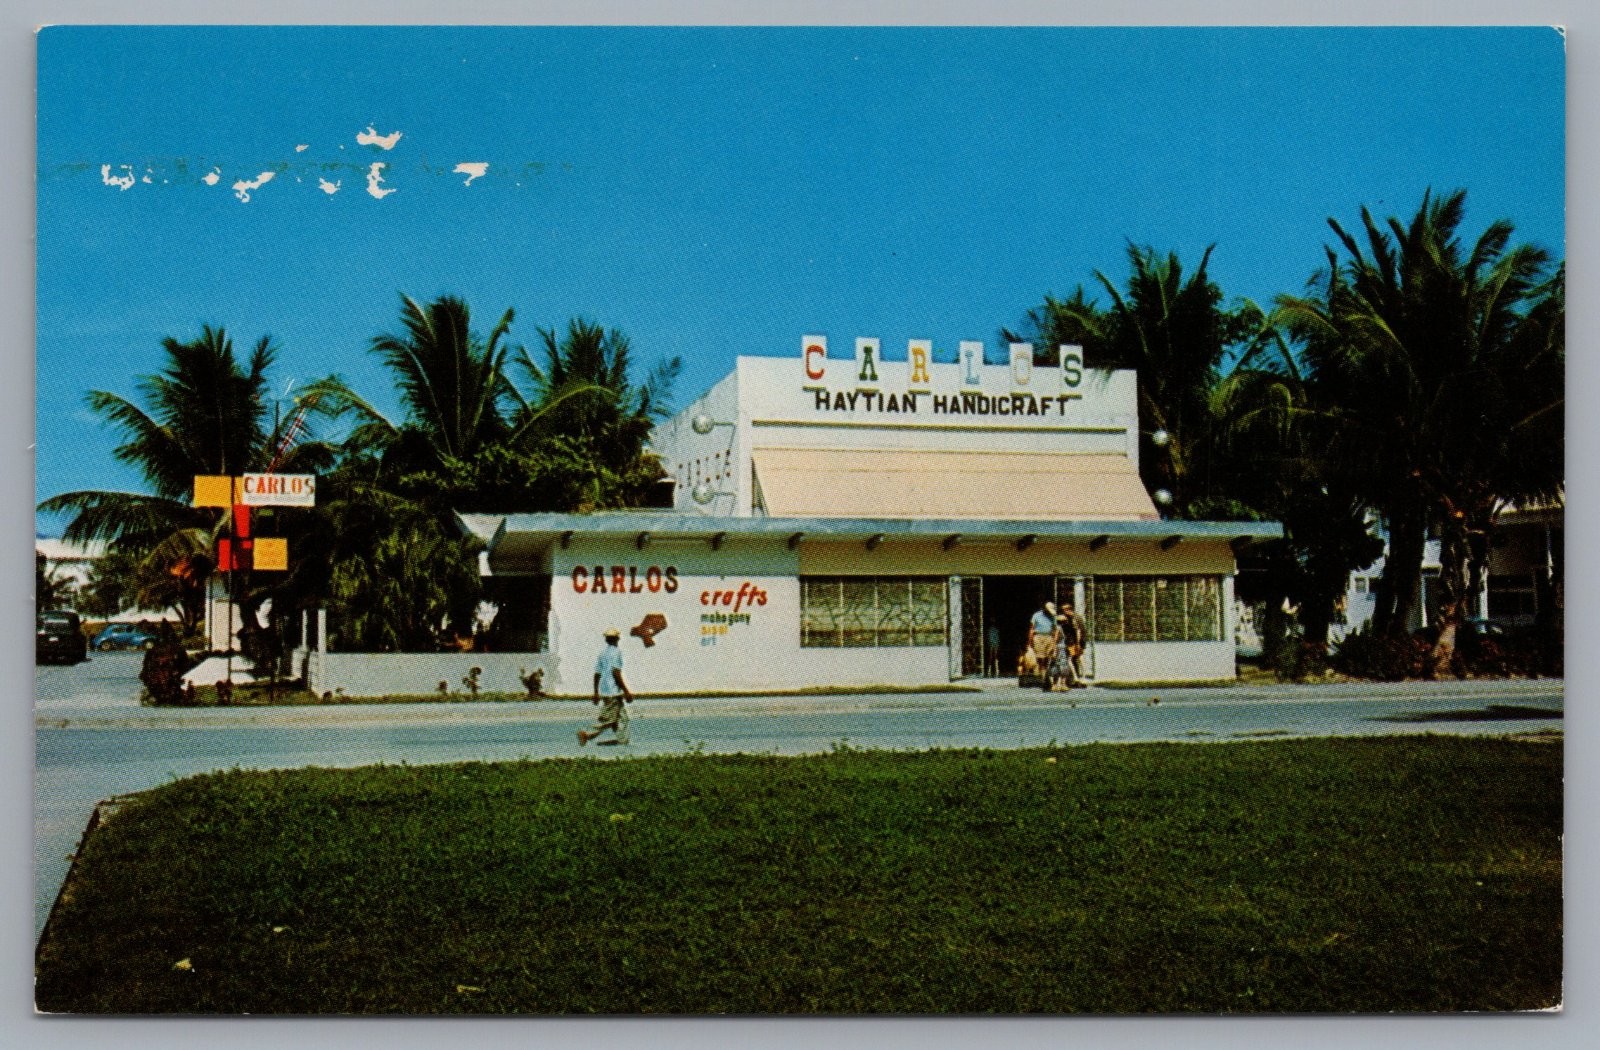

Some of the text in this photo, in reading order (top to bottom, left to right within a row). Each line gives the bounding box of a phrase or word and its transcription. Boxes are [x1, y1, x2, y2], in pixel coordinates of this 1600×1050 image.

[805, 345, 1082, 388] CARLOS
[815, 391, 1069, 416] HAYTIAN HANDICRAFT
[244, 476, 315, 495] CARLOS
[572, 565, 678, 593] CARLOS
[700, 582, 768, 612] crafts
